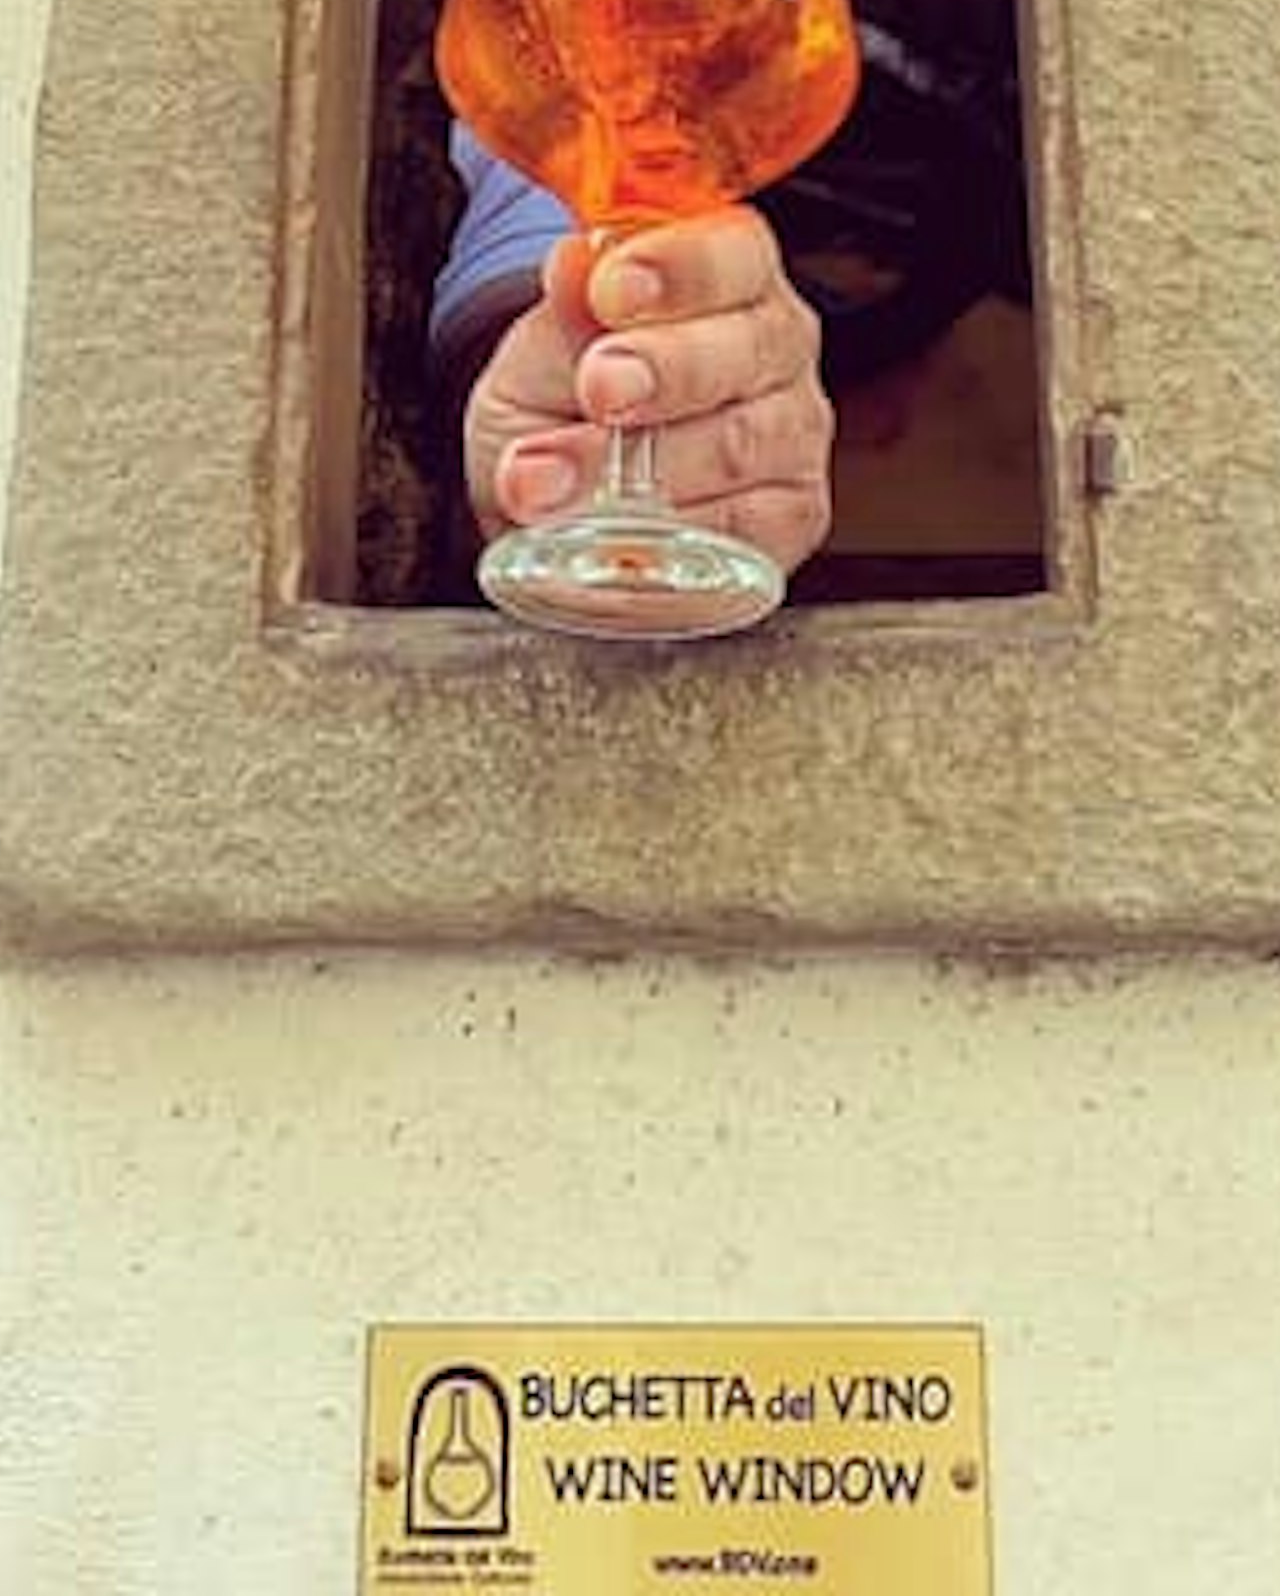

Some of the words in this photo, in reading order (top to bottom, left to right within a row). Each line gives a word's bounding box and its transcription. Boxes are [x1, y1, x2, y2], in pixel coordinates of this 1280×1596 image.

[519, 1374, 756, 1421] BUCHETTA
[765, 1382, 815, 1422] del
[827, 1375, 952, 1422] VINO
[543, 1456, 678, 1503] WINE
[695, 1456, 925, 1505] WINDOW
